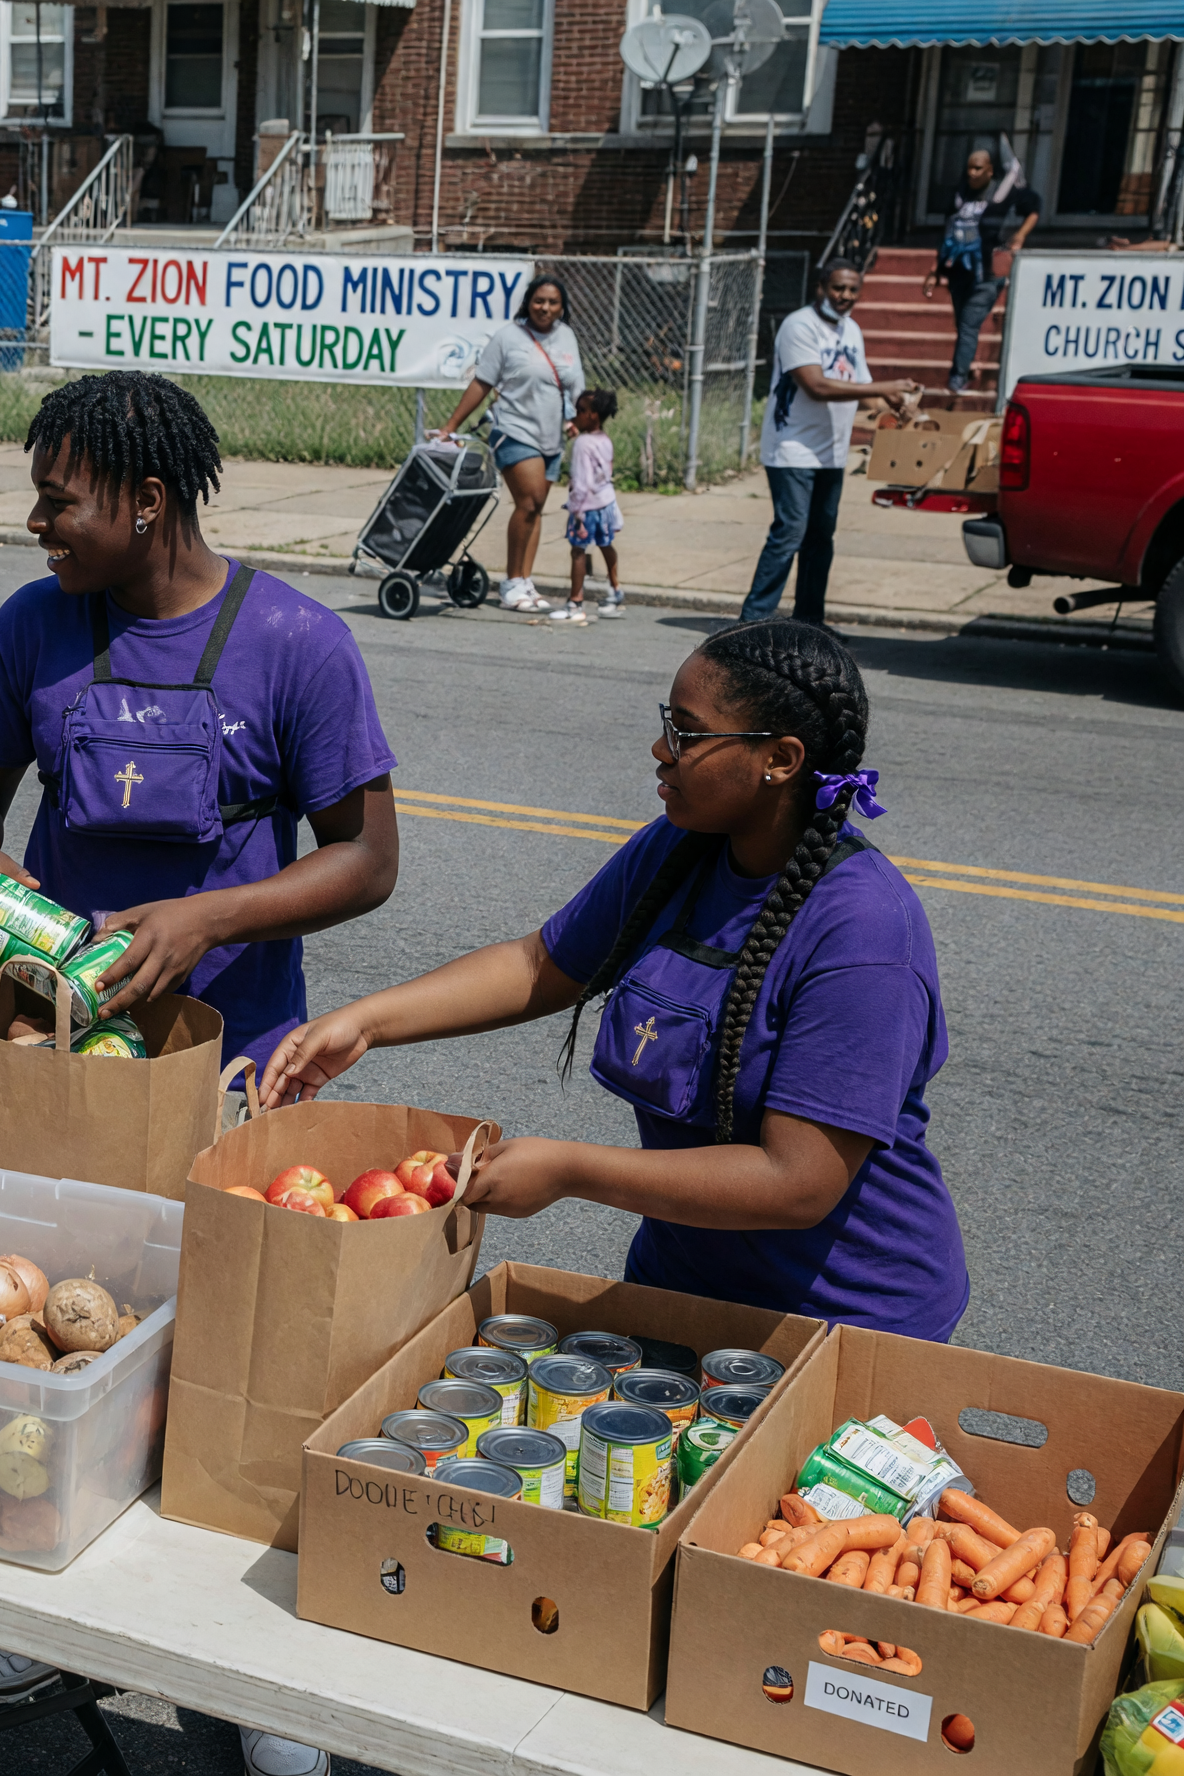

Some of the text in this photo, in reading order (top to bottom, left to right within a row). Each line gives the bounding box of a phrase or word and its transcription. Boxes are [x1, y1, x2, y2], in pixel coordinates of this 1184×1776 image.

[61, 256, 523, 320] MT. ZION FOOD MINISTRY
[1042, 274, 1086, 309] MT.
[1096, 275, 1171, 310] ZION
[105, 314, 214, 362] EVERY
[230, 320, 407, 373] SATURDAY
[1044, 325, 1162, 361] CHURCH
[824, 1682, 910, 1718] DONATED
